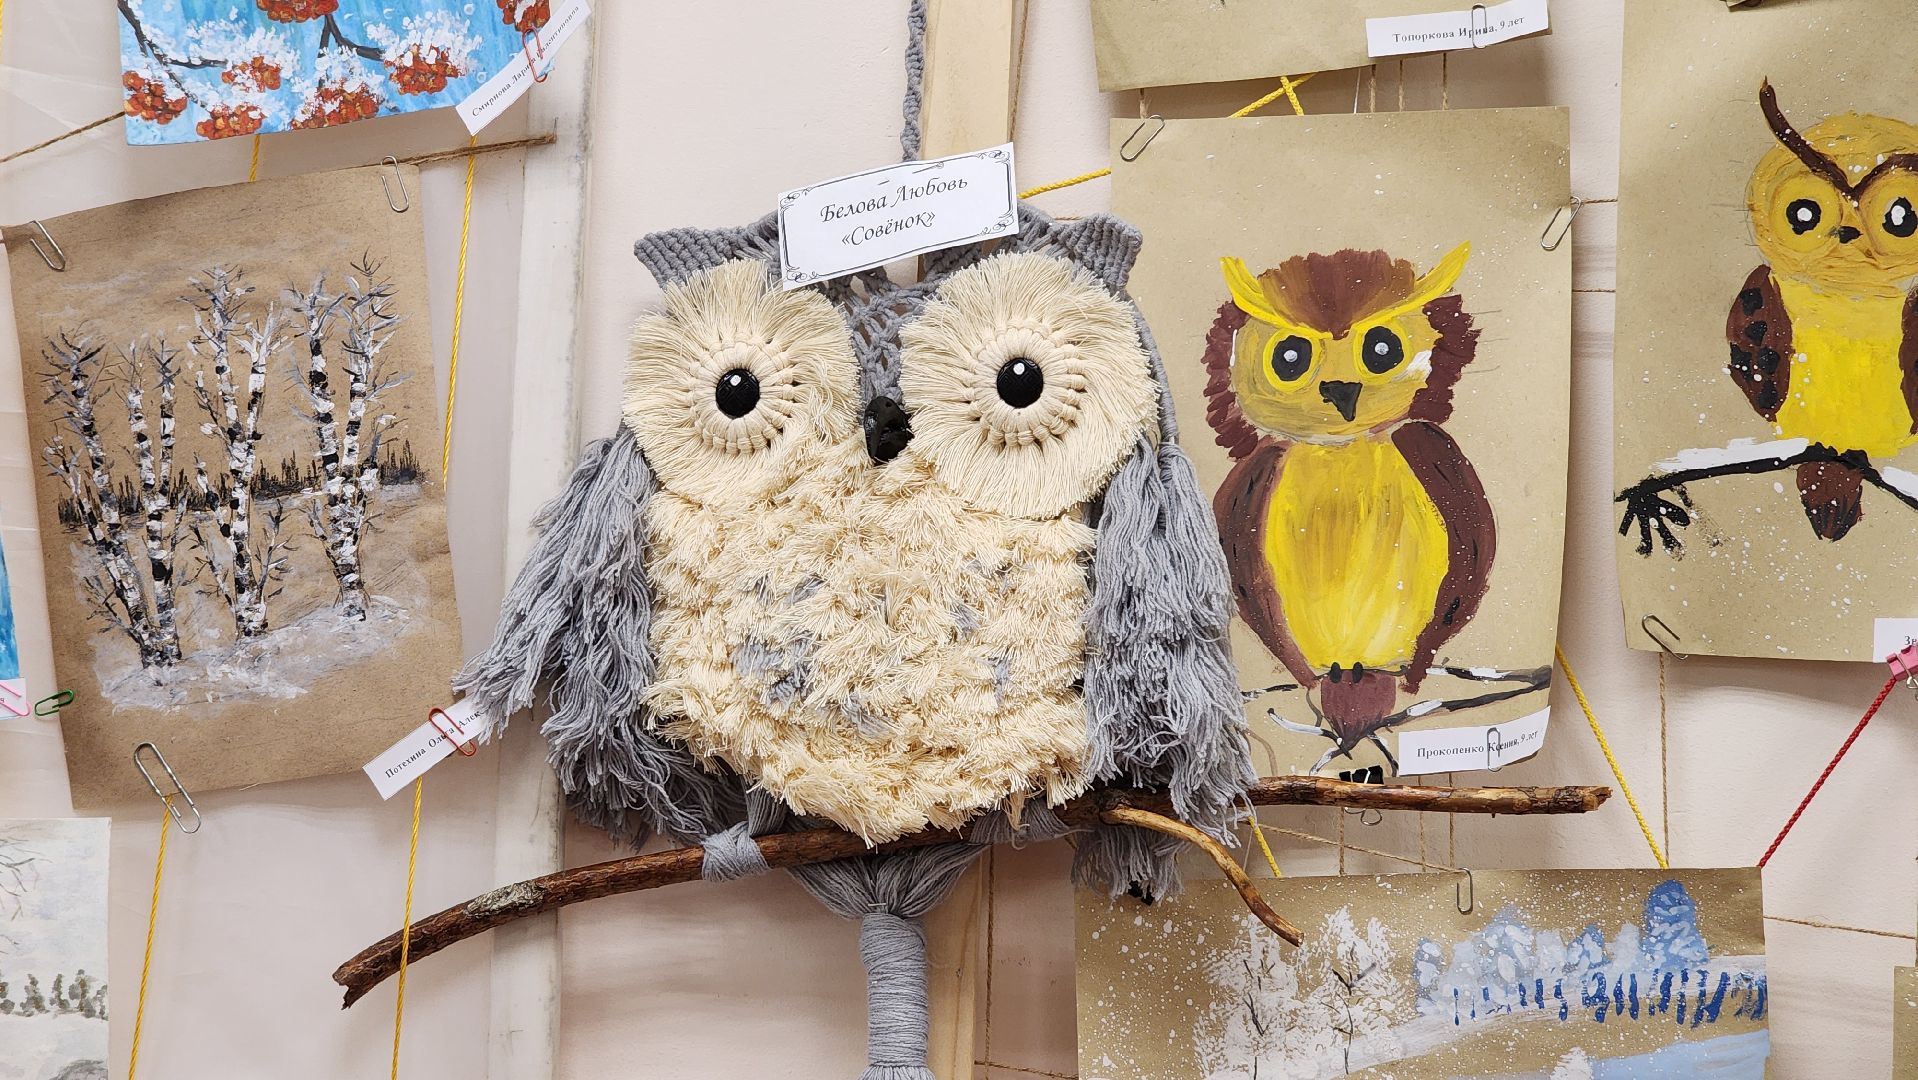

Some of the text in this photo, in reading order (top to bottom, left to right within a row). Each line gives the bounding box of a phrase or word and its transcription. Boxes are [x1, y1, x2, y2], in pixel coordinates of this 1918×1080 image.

[1393, 31, 1455, 43] Топоркова
[1499, 20, 1506, 30] 9
[1507, 16, 1525, 28] лет
[472, 83, 511, 117] Смирнова
[820, 177, 968, 223] Белова Любовь
[841, 211, 936, 246] «Совёнок»
[1417, 745, 1485, 759] Прокопенко
[1520, 733, 1526, 743] 9
[1526, 730, 1538, 742] лет
[385, 748, 426, 778] Потехина
